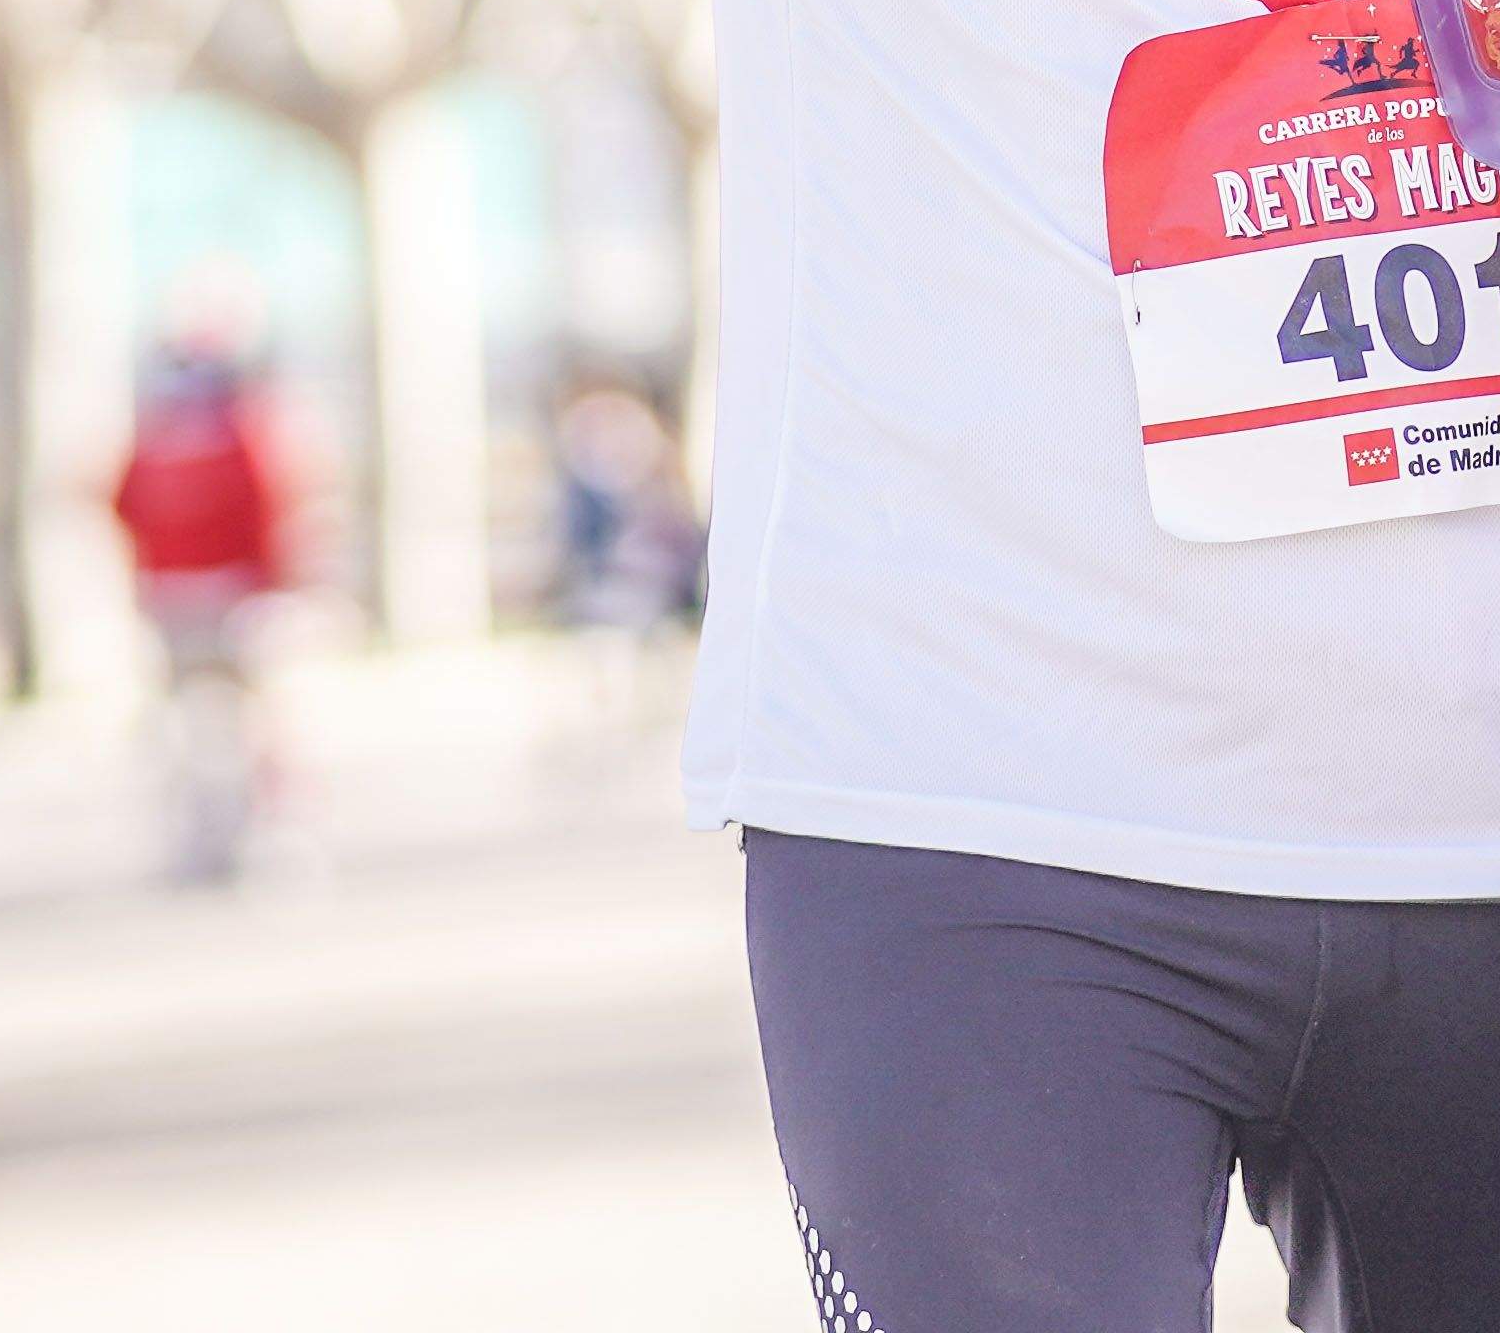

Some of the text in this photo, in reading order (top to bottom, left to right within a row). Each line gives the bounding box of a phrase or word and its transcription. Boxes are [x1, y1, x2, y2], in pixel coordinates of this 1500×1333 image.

[1257, 103, 1381, 145] CARRERA
[1367, 126, 1405, 144] de los
[1212, 153, 1377, 239] REYES
[1407, 453, 1442, 479] de
